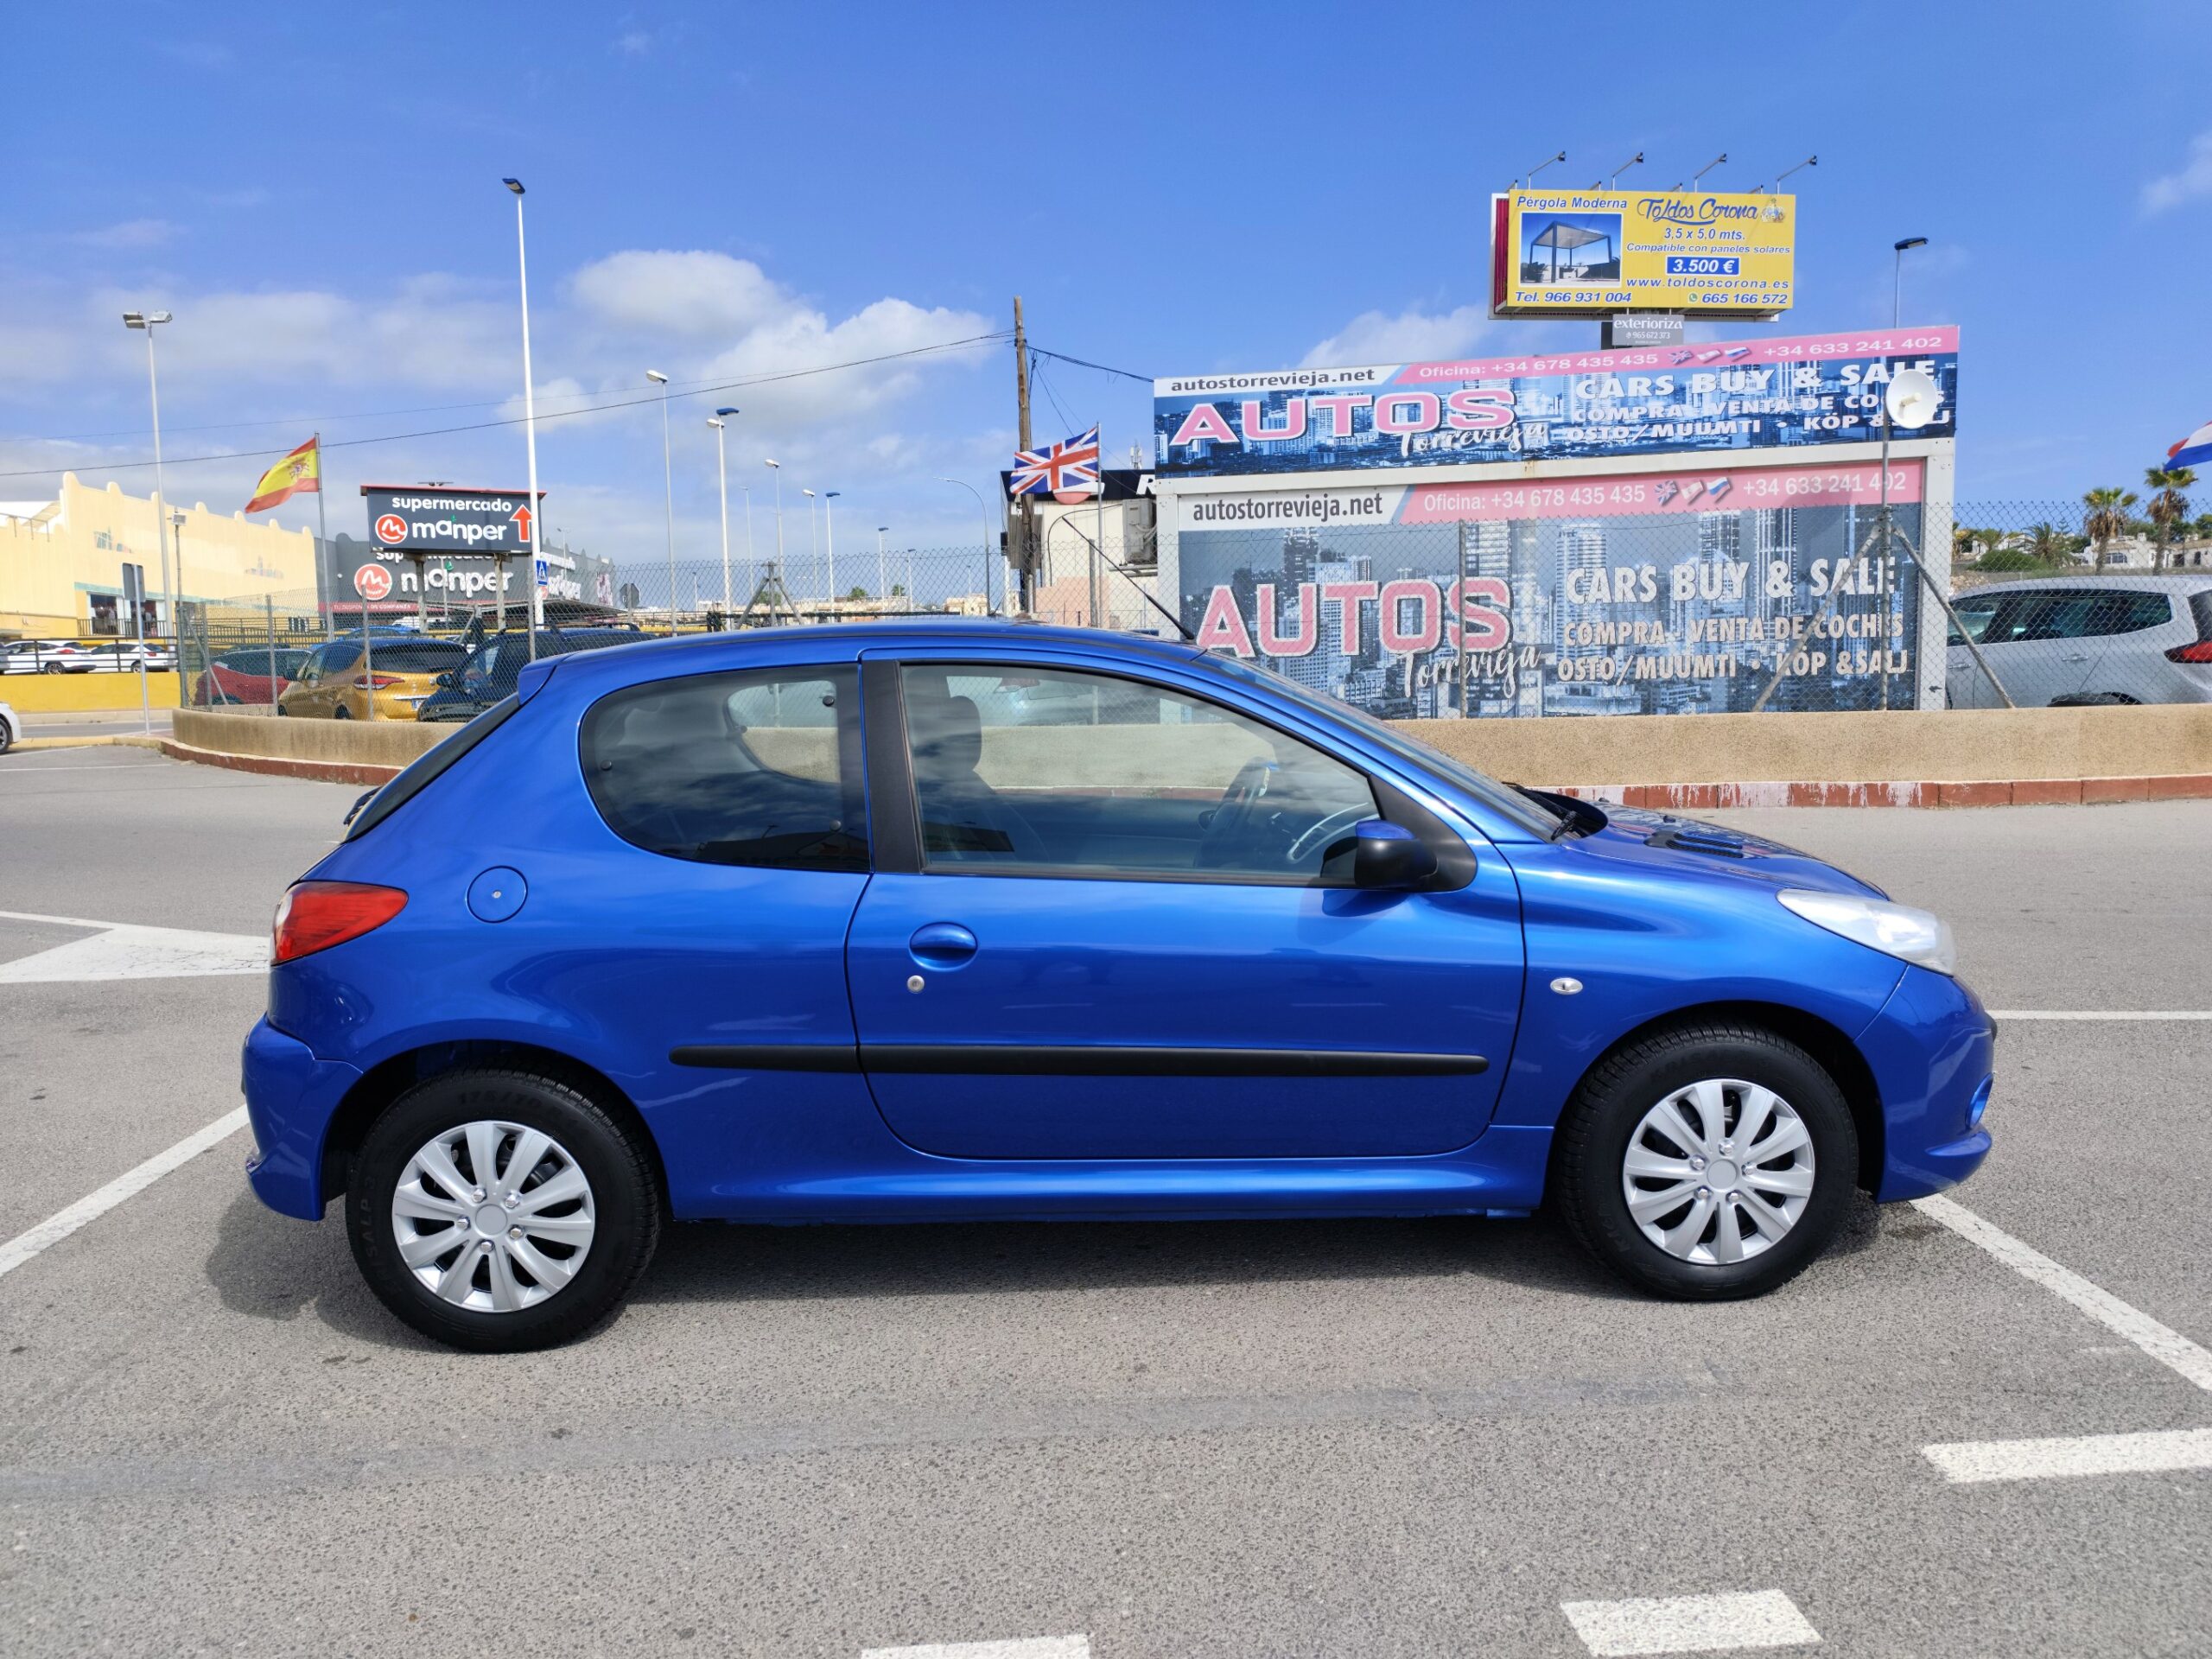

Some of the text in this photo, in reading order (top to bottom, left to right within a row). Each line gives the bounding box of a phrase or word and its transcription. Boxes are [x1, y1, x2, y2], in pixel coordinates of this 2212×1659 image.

[1517, 196, 1627, 210] Pérgola Moderna
[1699, 198, 1759, 219] Corona
[1664, 228, 1682, 240] 3,5
[1697, 228, 1715, 240] 5,0
[1719, 230, 1745, 240] mts.
[1627, 243, 1685, 252] Compatible
[1710, 245, 1751, 254] paneles
[1673, 259, 1735, 273] 3.500 €
[1627, 277, 1789, 289] www.toldoscorona.es
[1516, 292, 1631, 302] Tel. 966 931 004
[1702, 294, 1788, 304] 665 166 572
[1613, 317, 1683, 329] exterioriza
[1632, 331, 1645, 340] 965
[1646, 331, 1658, 340] 672
[1764, 337, 1942, 357] +34 633 241 402
[1420, 353, 1658, 378] Oficina: +34 678 435 435
[1171, 368, 1376, 391] autostorrevieja.net
[1575, 375, 1675, 399] CARS
[1692, 369, 1776, 394] BUY
[1792, 367, 1823, 388] &
[1168, 388, 1519, 447] AUTOS
[1573, 404, 1686, 422] COMPRA
[1712, 397, 1792, 416] VENTA
[1801, 396, 1834, 411] DE
[1804, 412, 1859, 430] KÖP
[1395, 422, 1547, 457] Torrevieja
[1743, 479, 1780, 496] +34
[1785, 476, 1822, 495] 633
[1827, 474, 1863, 493] 241
[391, 497, 512, 512] supermercado
[1193, 493, 1382, 522] autostorrevieja.net
[1424, 485, 1645, 512] Oficina: +34 678 435 435
[412, 519, 507, 545] manper
[1566, 565, 1657, 605] CARS
[1673, 561, 1750, 601] BUY
[1765, 560, 1795, 599] &
[1195, 576, 1512, 658] AUTOS
[1563, 620, 1666, 646] COMPRA
[1690, 616, 1765, 643] VENTA
[1775, 616, 1804, 640] DE
